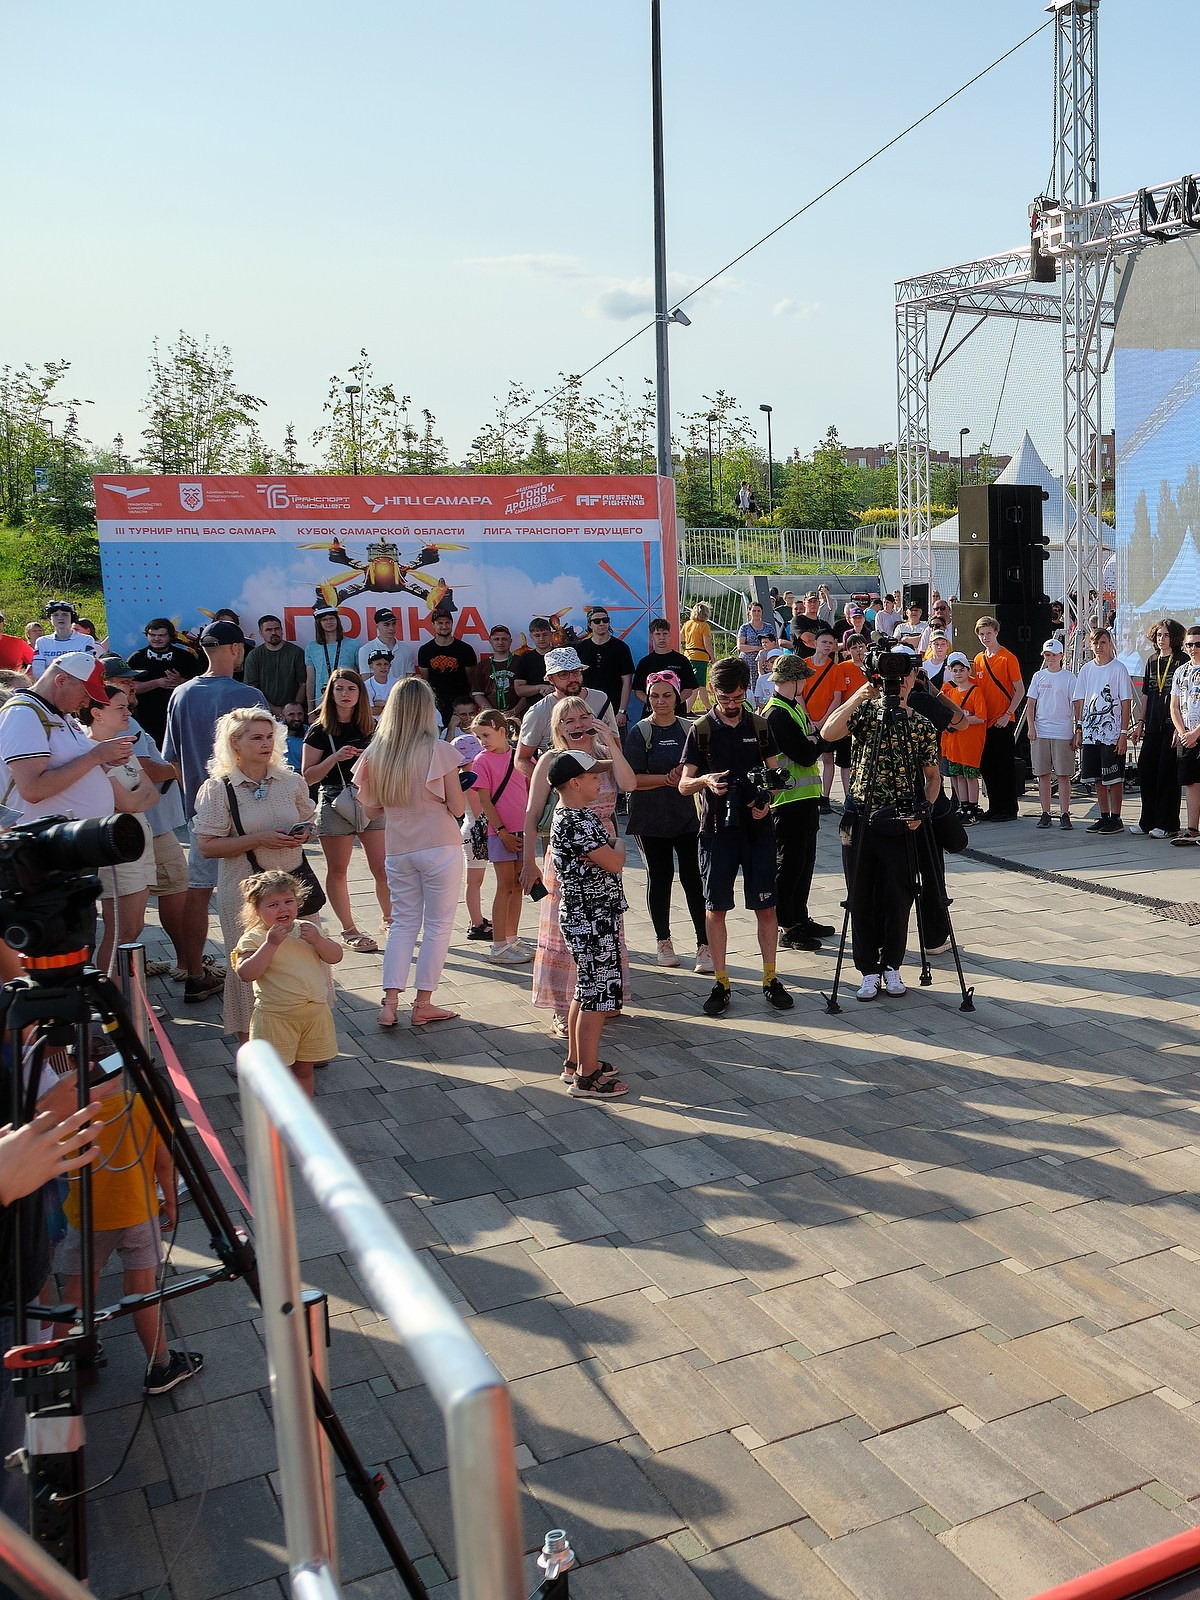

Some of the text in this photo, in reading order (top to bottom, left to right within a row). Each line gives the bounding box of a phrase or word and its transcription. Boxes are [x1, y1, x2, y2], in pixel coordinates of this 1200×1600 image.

[520, 483, 555, 501] ГОНОК
[384, 496, 493, 506] НПЦ САМАРА
[504, 494, 548, 515] ДРОНОВ
[128, 527, 173, 535] ТУРНИР
[176, 527, 200, 536] НПЦ
[202, 527, 226, 535] БАС
[229, 527, 277, 535] САМАРА
[297, 526, 466, 535] КУБОК САМАРСКОЙ ОБЛАСТИ
[483, 527, 644, 536] ЛИГА ТРАНСПОРТ БУДУЩЕГО
